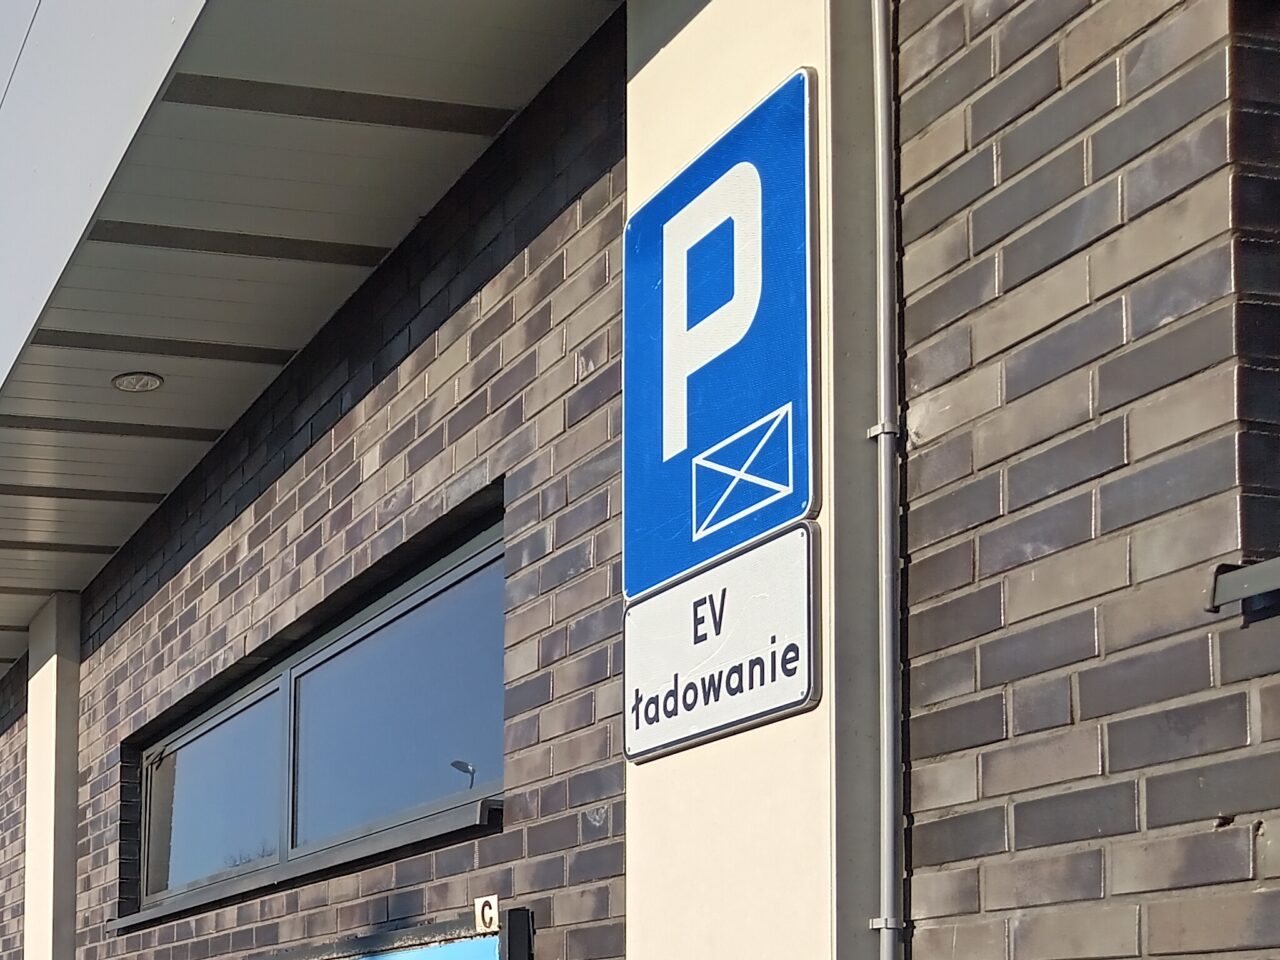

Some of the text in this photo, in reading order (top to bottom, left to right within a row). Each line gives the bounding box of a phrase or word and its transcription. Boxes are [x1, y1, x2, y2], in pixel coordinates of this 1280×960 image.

[663, 161, 762, 462] P
[693, 588, 727, 645] EV
[632, 635, 800, 730] ładowanie
[481, 900, 492, 928] C
